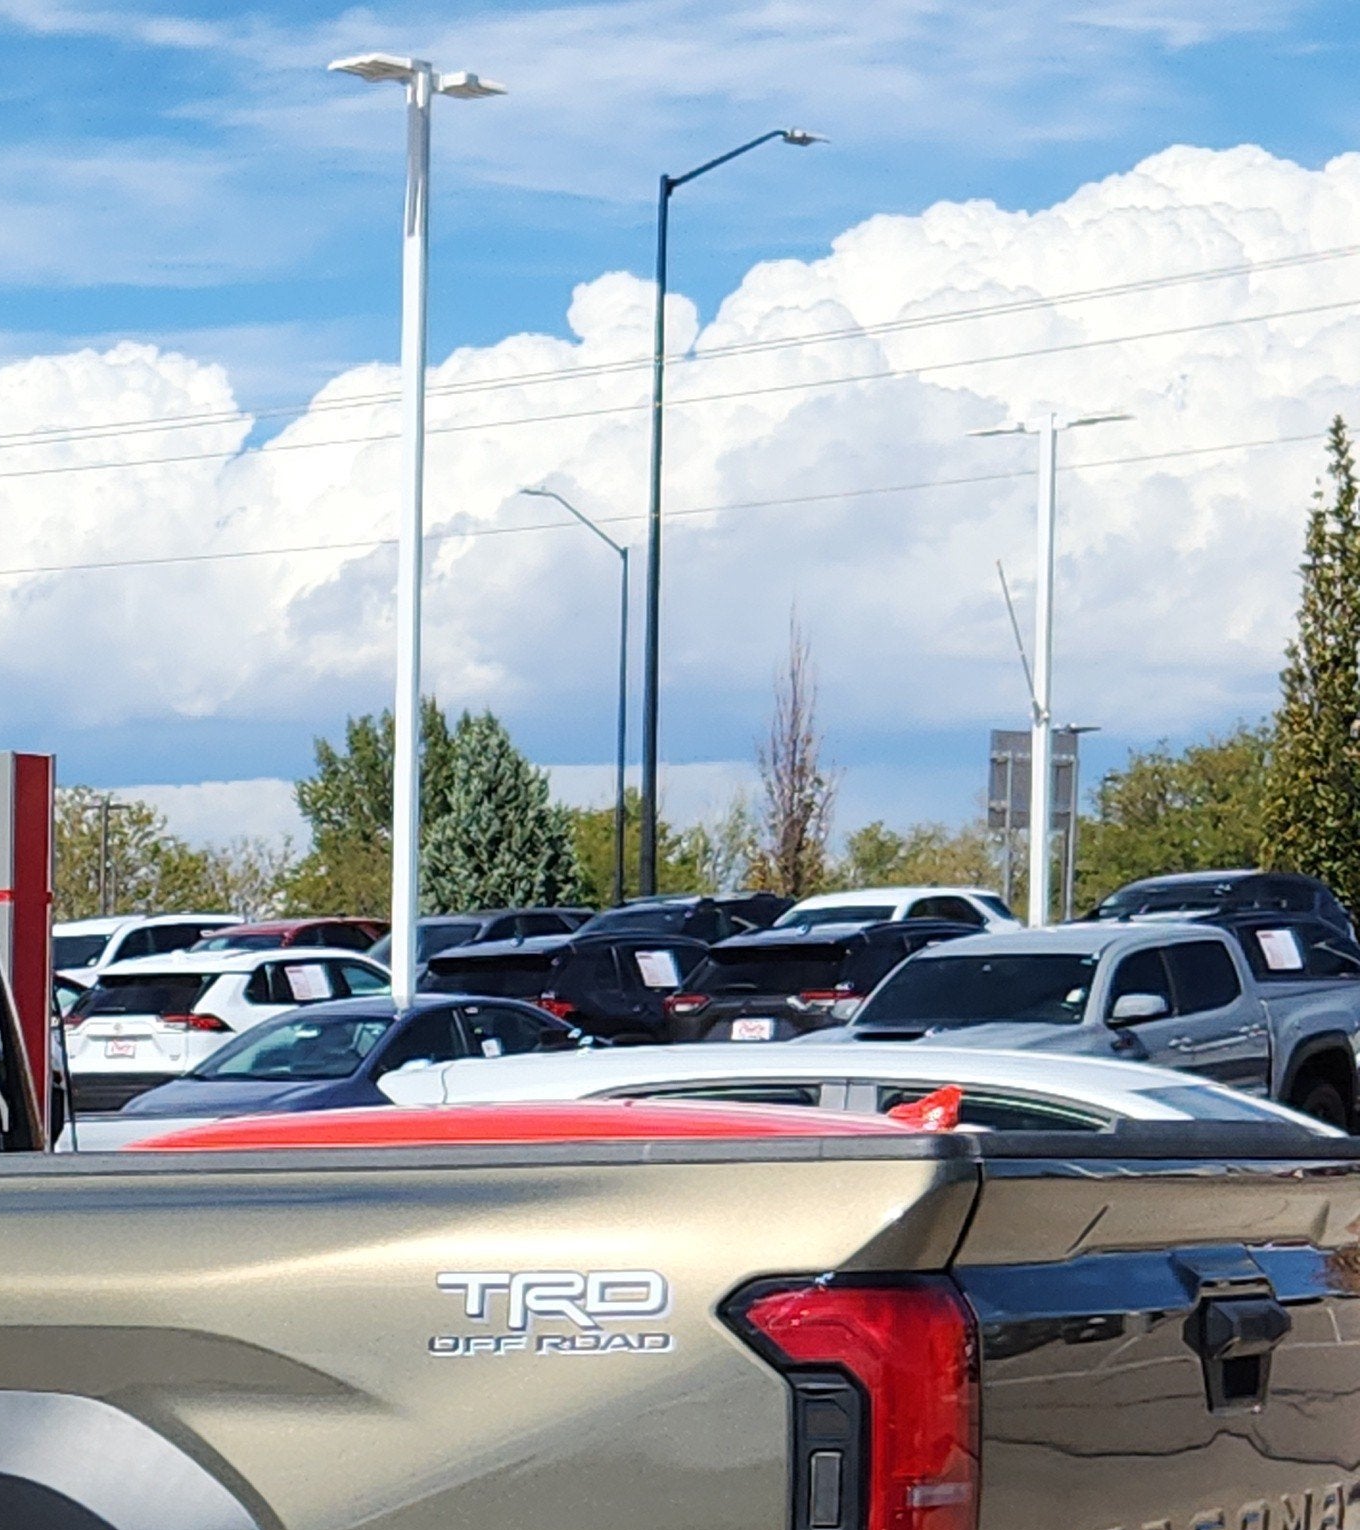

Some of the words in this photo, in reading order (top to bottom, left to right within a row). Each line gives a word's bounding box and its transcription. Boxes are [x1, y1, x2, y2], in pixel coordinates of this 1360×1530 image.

[436, 1270, 669, 1330] TRD
[429, 1334, 527, 1357] OFF
[534, 1332, 675, 1355] ROAD
